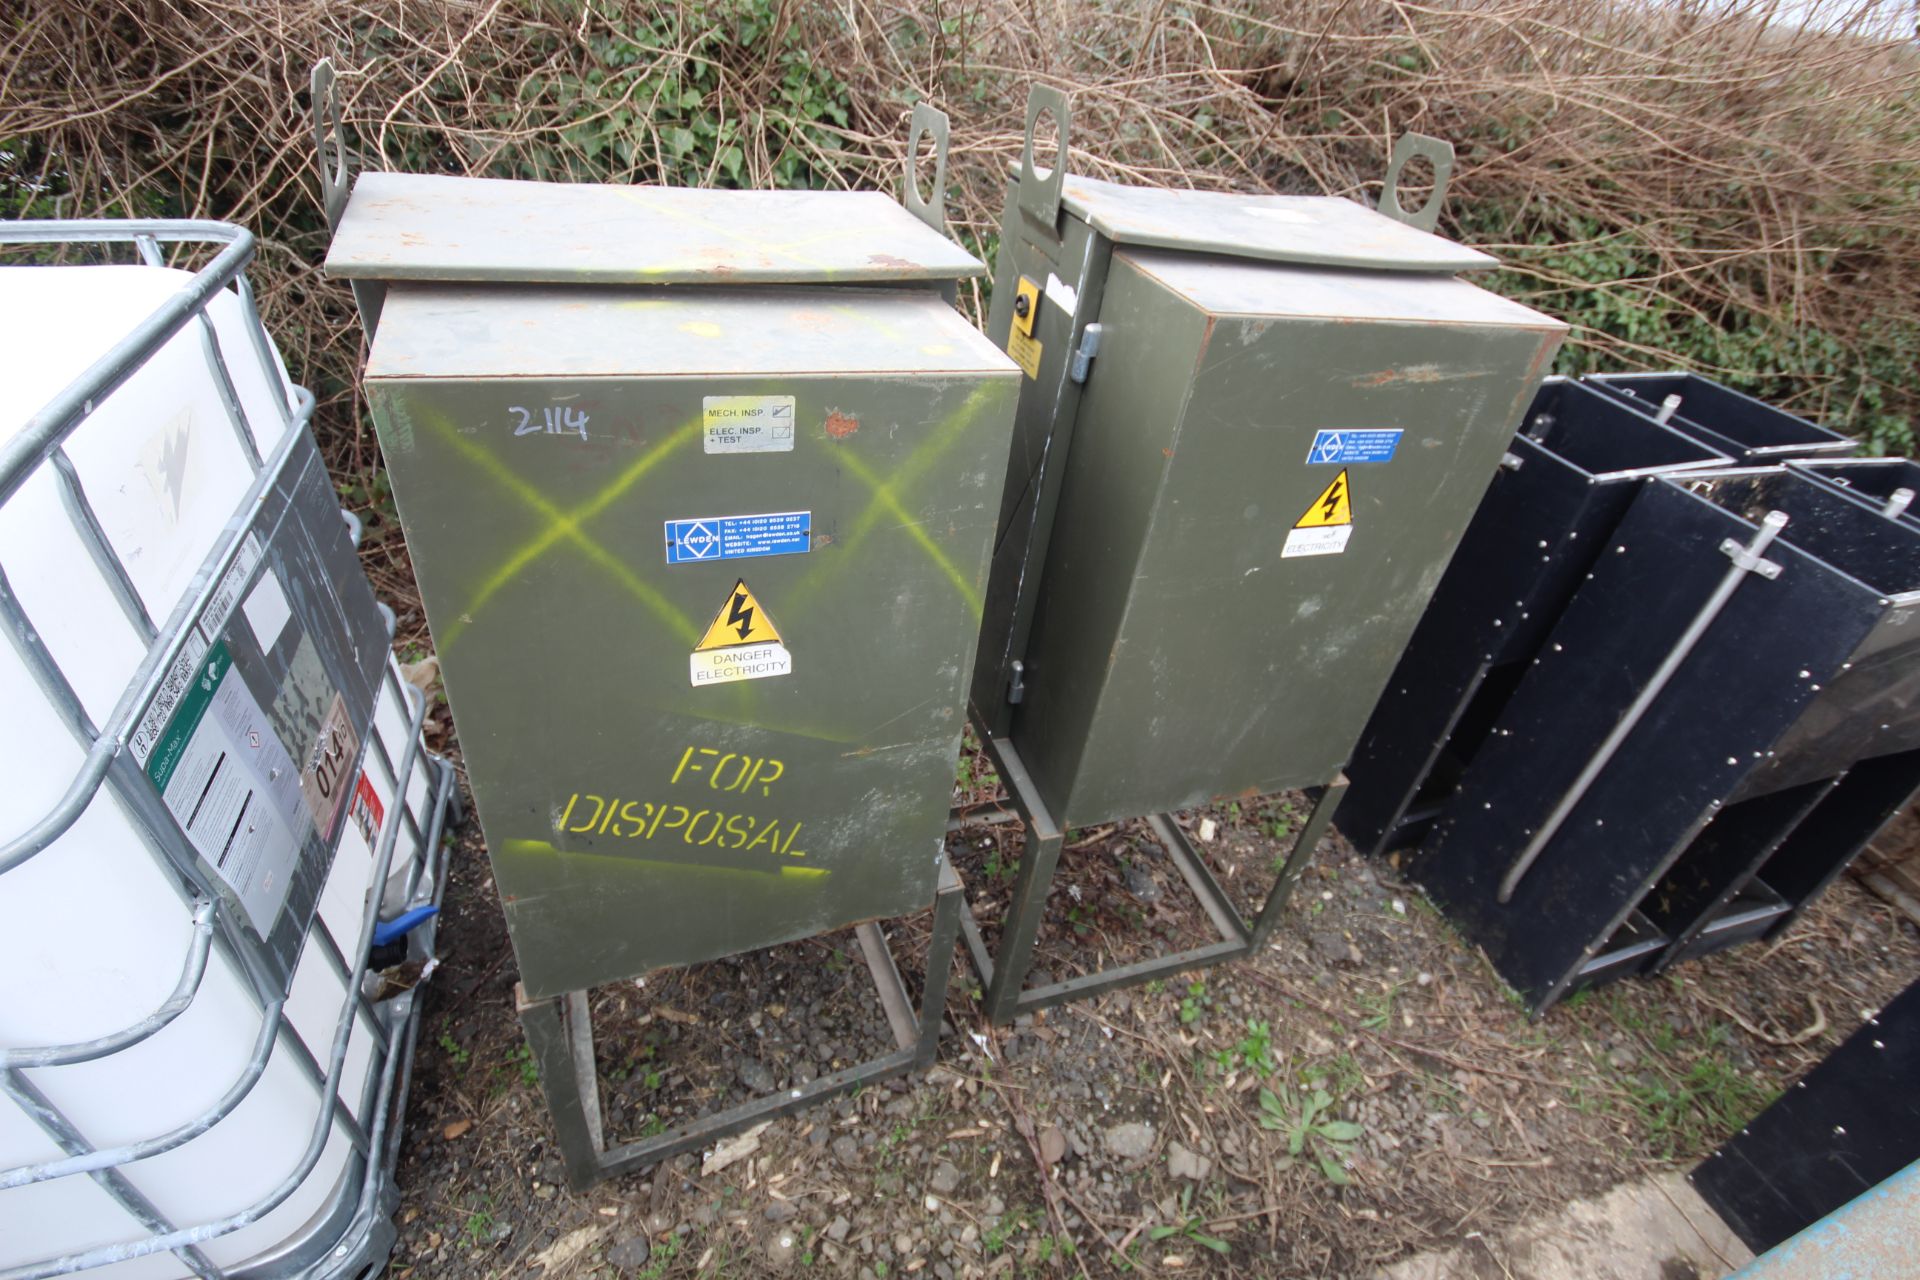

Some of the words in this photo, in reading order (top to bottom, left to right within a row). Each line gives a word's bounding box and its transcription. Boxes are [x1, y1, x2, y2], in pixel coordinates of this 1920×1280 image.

[708, 409, 740, 417] MECH.
[741, 409, 765, 417] INSP.
[508, 406, 590, 441] 2114
[739, 427, 763, 435] INSP.
[678, 535, 720, 545] LEWDEN
[713, 650, 772, 665] DANGER
[697, 661, 786, 681] ELECTRICITY
[315, 731, 344, 799] 014
[671, 746, 785, 797] FOR
[558, 793, 806, 857] DISPOSAL
